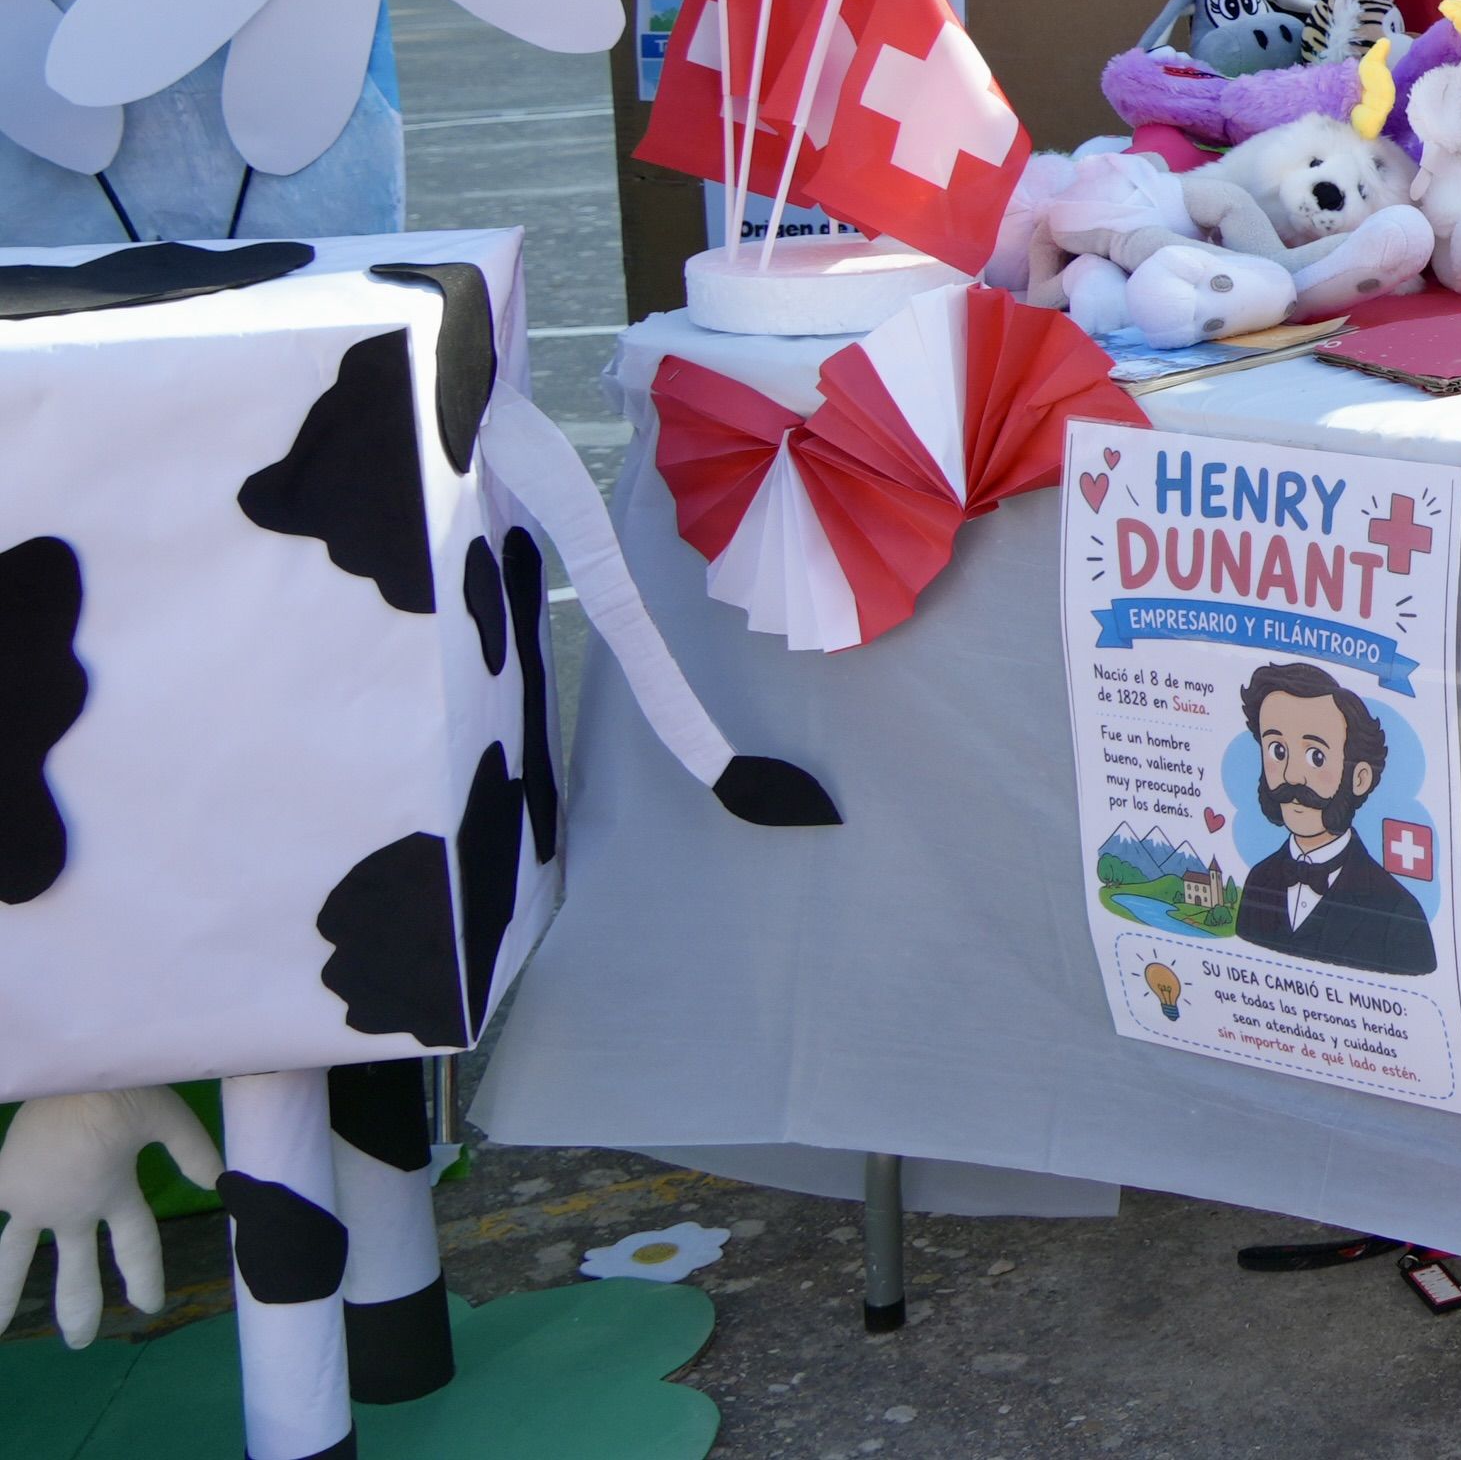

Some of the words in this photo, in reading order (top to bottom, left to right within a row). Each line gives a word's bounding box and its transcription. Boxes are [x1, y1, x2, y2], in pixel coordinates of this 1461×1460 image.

[1155, 450, 1346, 535] HENRY
[1116, 518, 1384, 619] DUNANT
[1129, 608, 1236, 634] EMPRESARIO
[1245, 619, 1254, 637] Y
[1264, 619, 1380, 664] FILÁNTROPO
[1093, 664, 1127, 682] Nació
[1134, 668, 1144, 684] el
[1150, 671, 1158, 685] 8
[1164, 672, 1179, 689] de
[1184, 677, 1214, 697] mayo
[1098, 688, 1112, 702] de
[1117, 689, 1148, 708] 1828
[1153, 697, 1167, 709] en
[1173, 696, 1210, 715] Suiza.
[1101, 725, 1122, 742] Fue
[1127, 733, 1141, 743] un
[1146, 731, 1191, 752] hombre
[1103, 749, 1142, 769] bueno,
[1146, 754, 1193, 775] valiente
[1198, 764, 1204, 780] y
[1107, 773, 1130, 791] muy
[1135, 777, 1201, 797] preocupado
[1109, 796, 1128, 810] por
[1133, 795, 1149, 813] los
[1153, 797, 1193, 818] demás.
[1202, 961, 1222, 978] SU
[1227, 966, 1259, 986] IDEA
[1264, 974, 1319, 999] CAMBIÓ
[1326, 987, 1343, 1004] EL
[1349, 992, 1407, 1017] MUNDO:
